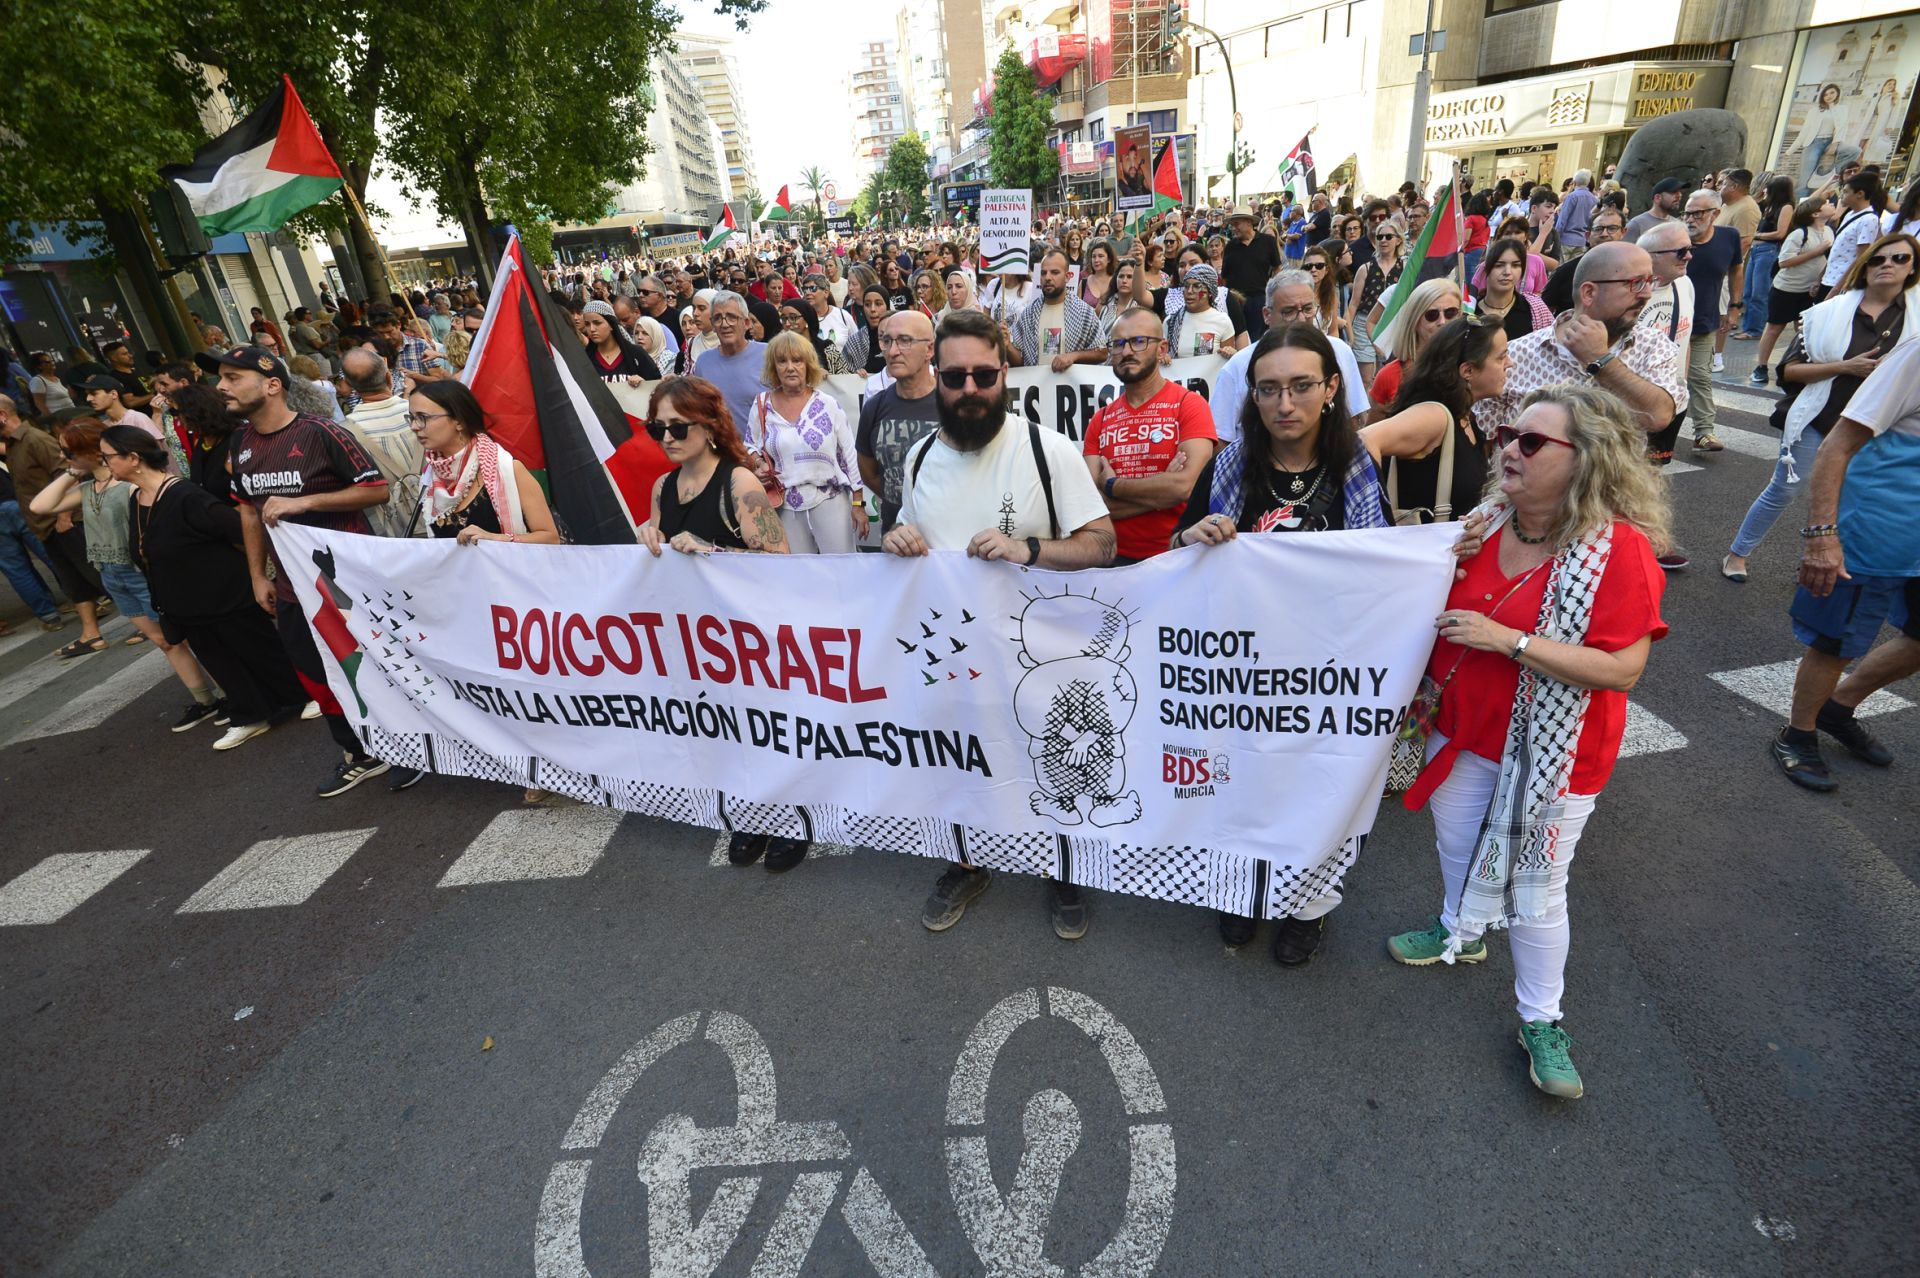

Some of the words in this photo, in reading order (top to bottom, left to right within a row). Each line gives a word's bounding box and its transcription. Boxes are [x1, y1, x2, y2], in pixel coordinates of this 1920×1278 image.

[1640, 71, 1697, 92] EDIFICIO
[1635, 96, 1694, 117] HISPANIA
[984, 195, 1026, 203] CARTAGENA
[984, 203, 1026, 212] PALESTINA
[827, 219, 851, 229] Israel
[989, 217, 1009, 225] ALTO
[1011, 217, 1021, 225] AL
[652, 236, 673, 248] GAZA
[674, 233, 697, 244] MUERE
[982, 229, 1026, 238] GENOCIDIO
[653, 247, 678, 259] EUROPA
[998, 242, 1008, 250] YA
[252, 470, 303, 488] BRIGADA
[252, 483, 305, 495] internacional
[1158, 626, 1259, 664] BOICOT,
[490, 604, 668, 677] BOICOT
[676, 614, 888, 704] ISRAEL
[1159, 658, 1360, 697] DESINVERSIÓN
[1367, 667, 1389, 697] Y
[1159, 698, 1311, 734] SANCIONES
[1317, 706, 1338, 735] A
[514, 690, 560, 725] LA
[553, 690, 742, 744] LIBERACIÓN
[745, 707, 790, 755] DE
[795, 716, 993, 778] PALESTINA
[1162, 743, 1208, 758] MOVIMIENTO
[1162, 752, 1211, 786] BDS
[1174, 784, 1216, 800] MURCIA
